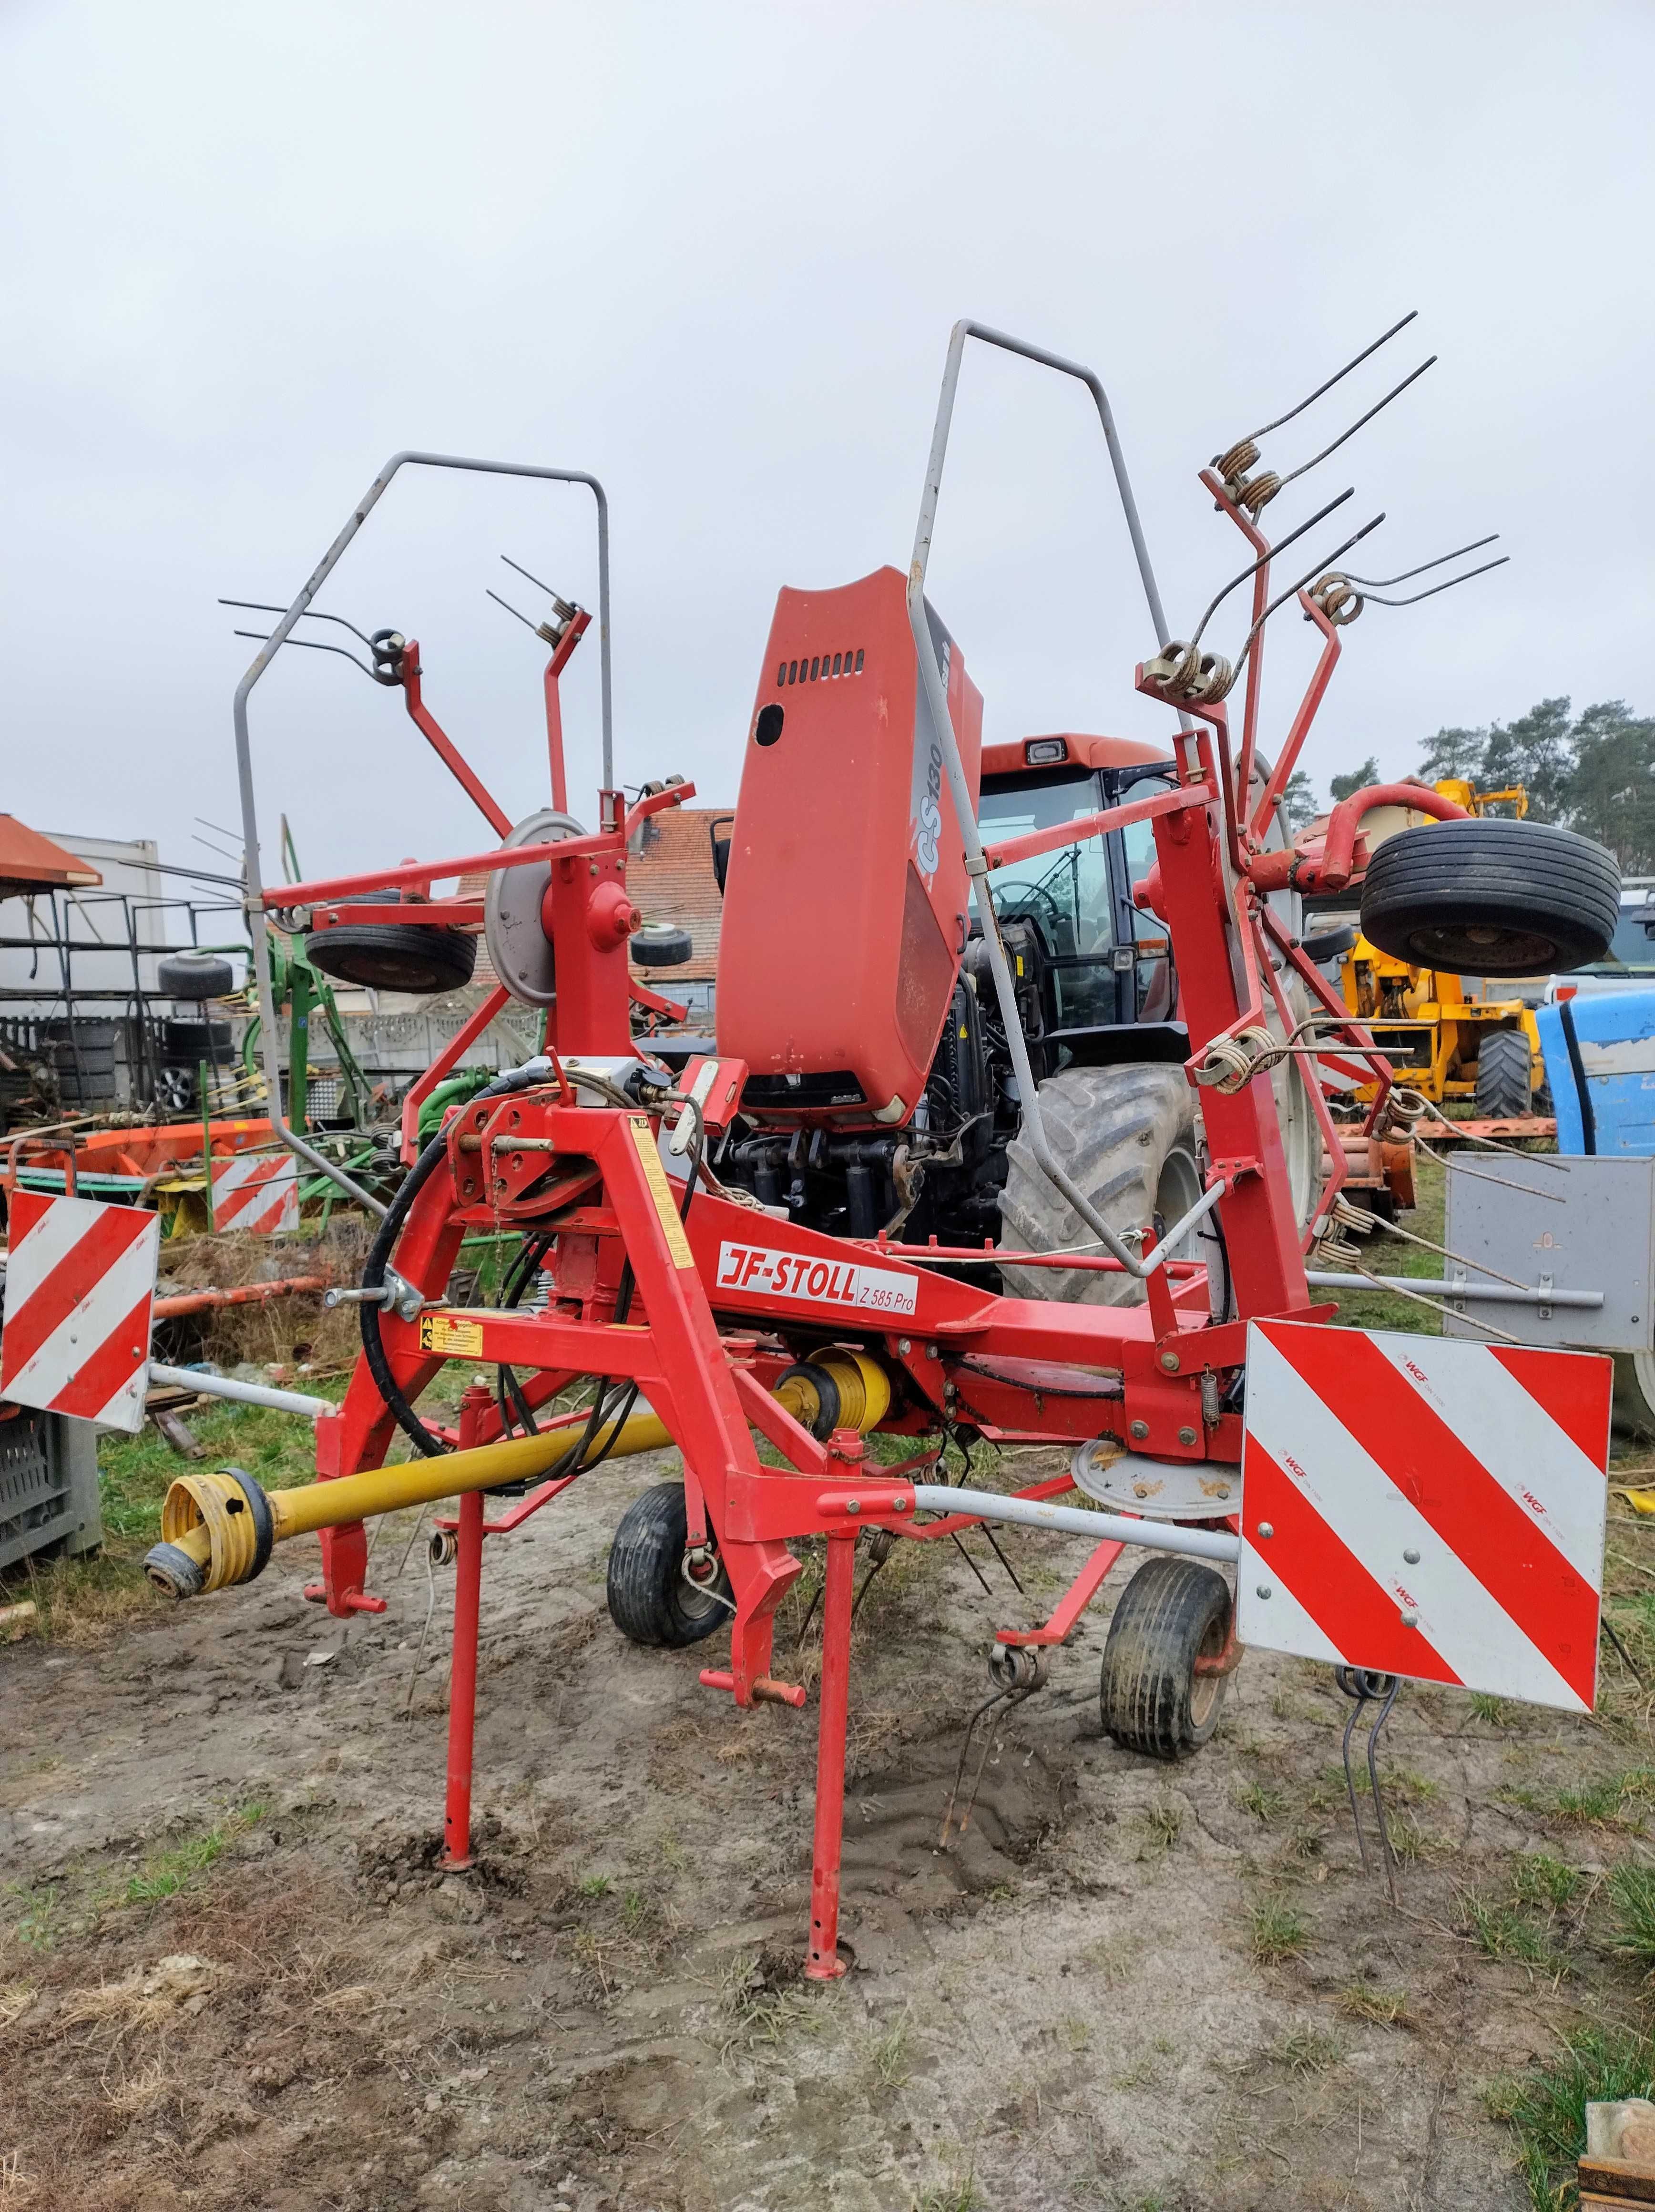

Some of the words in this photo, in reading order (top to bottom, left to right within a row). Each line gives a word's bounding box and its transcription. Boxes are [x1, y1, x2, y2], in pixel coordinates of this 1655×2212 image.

[926, 744, 942, 801] 130
[917, 796, 941, 874] CS
[720, 1249, 855, 1301] JF-STOLL
[859, 1287, 869, 1303] Z
[871, 1290, 893, 1307] 585
[894, 1293, 913, 1311] Pro
[1406, 1361, 1429, 1382] WGF
[1286, 1456, 1307, 1477] WGF
[1523, 1492, 1547, 1514] WGF
[1396, 1586, 1419, 1608] WGF
